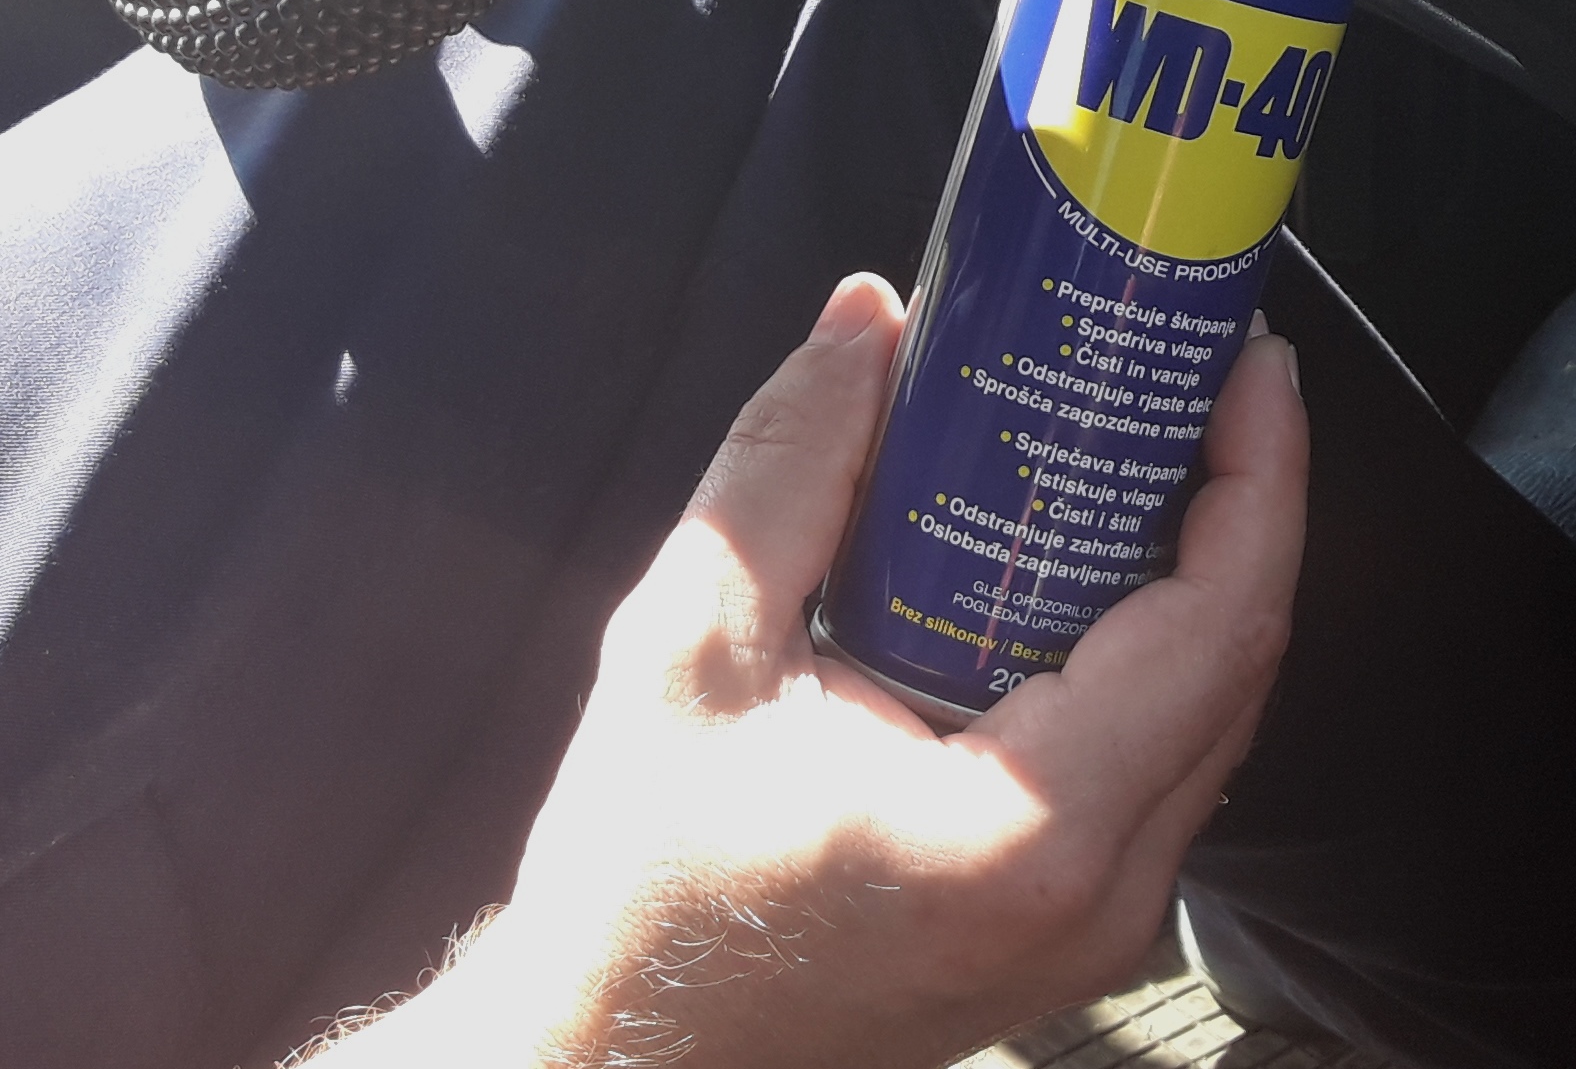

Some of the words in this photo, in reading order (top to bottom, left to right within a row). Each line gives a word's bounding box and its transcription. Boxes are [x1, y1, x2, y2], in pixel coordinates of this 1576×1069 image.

[1057, 199, 1171, 279] MULTI-USE
[1174, 247, 1262, 282] PRODUCT
[1056, 280, 1167, 328] Preprečuje
[1169, 310, 1237, 339] škripanje
[1075, 343, 1123, 376] Čisti
[1127, 359, 1146, 380] in
[1151, 368, 1200, 391] varuje
[1077, 317, 1167, 356] Spodriva
[1170, 340, 1213, 364] vlago
[972, 368, 1053, 413] Sprošča
[1056, 401, 1161, 440] zagozdene
[1017, 356, 1134, 410] Odstranjuje
[1138, 391, 1185, 414] rjaste
[1014, 431, 1115, 475] Sprječava
[1118, 455, 1188, 484] škripanje
[1033, 468, 1118, 507] Istiskuje
[1122, 487, 1165, 512] vlagu
[1047, 496, 1094, 527] Čisti
[1097, 509, 1107, 529] i
[1108, 512, 1143, 533] štiti
[920, 517, 1011, 564] Oslobađa
[1014, 552, 1121, 587] zaglavljene
[949, 496, 1065, 549] Odstranjuje
[1069, 534, 1143, 560] zahrđale
[952, 592, 1031, 627] POGLEDAJ
[1031, 617, 1089, 637] UPOZOR
[972, 580, 1008, 602] GLEJ
[1012, 592, 1092, 620] OPOZORILO
[890, 597, 922, 624] Brez
[925, 614, 998, 651] silikonov
[1010, 642, 1041, 661] Bez
